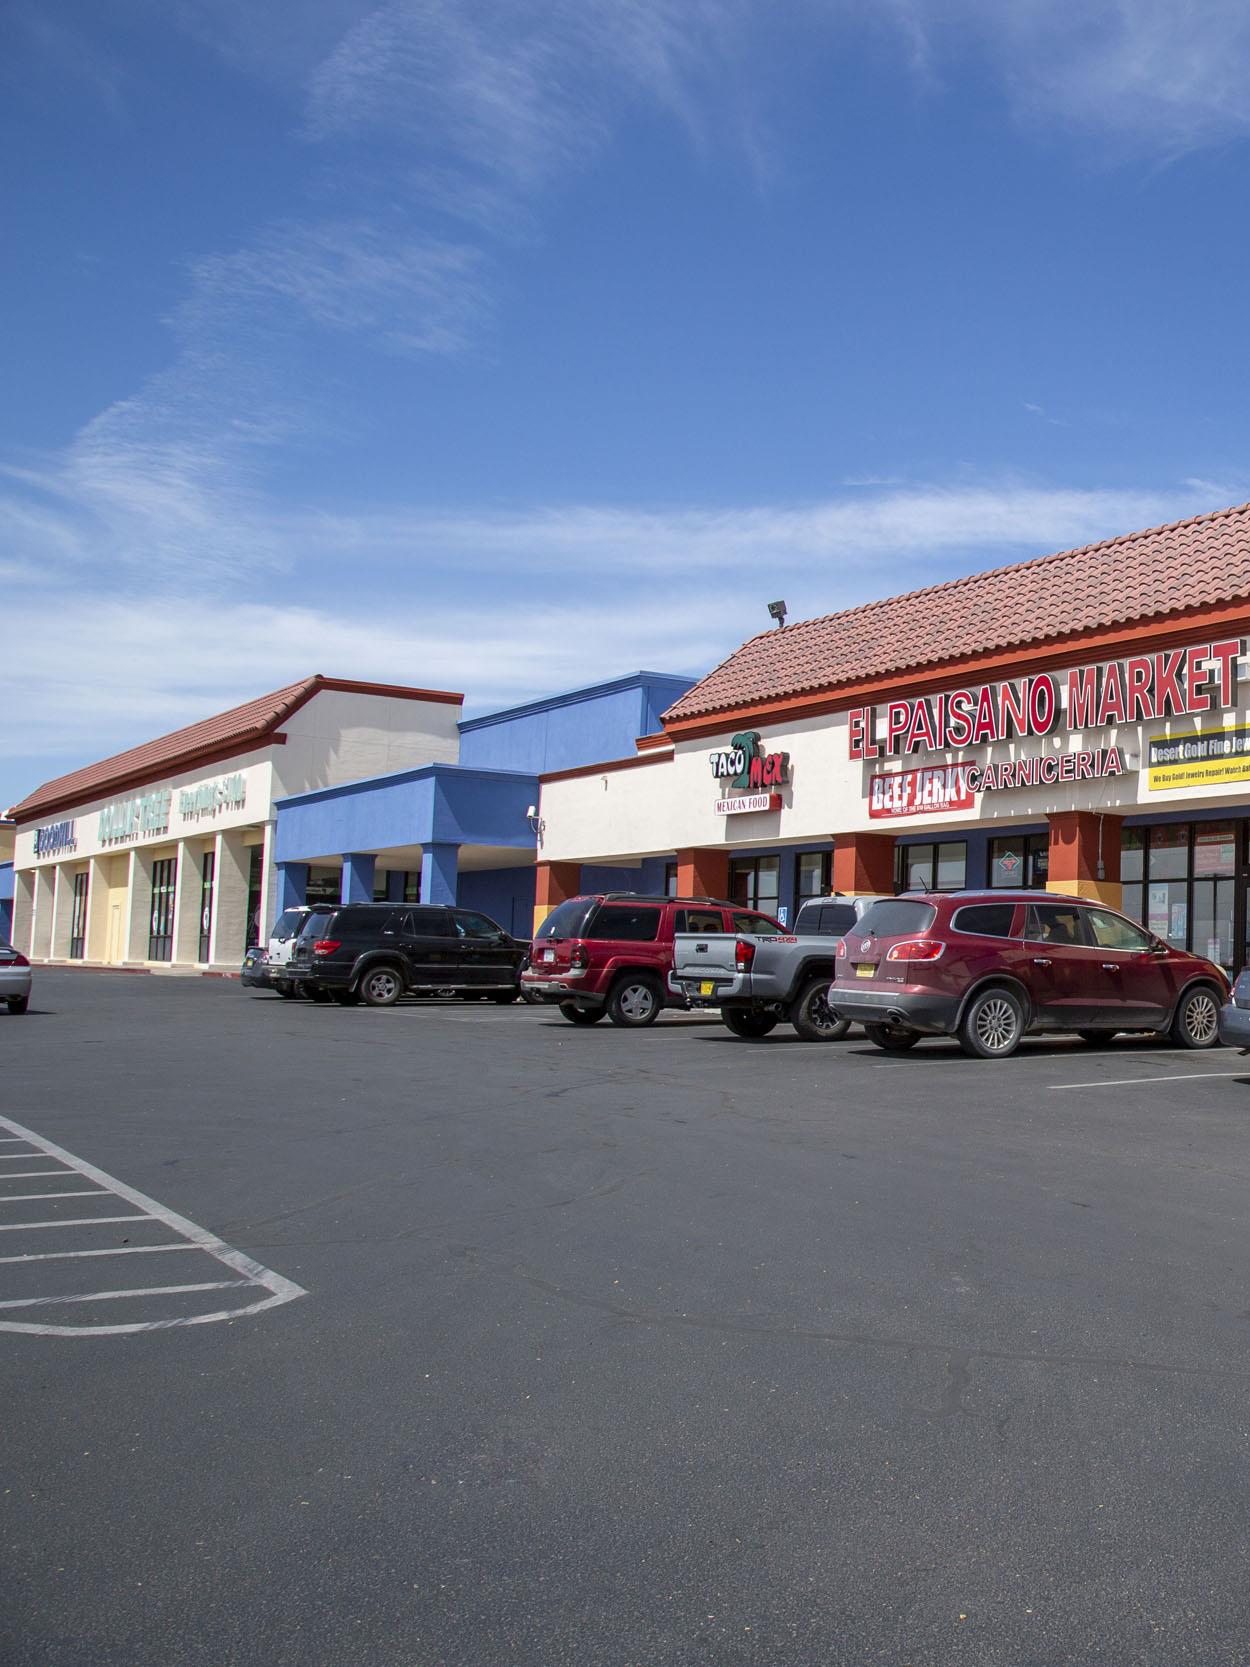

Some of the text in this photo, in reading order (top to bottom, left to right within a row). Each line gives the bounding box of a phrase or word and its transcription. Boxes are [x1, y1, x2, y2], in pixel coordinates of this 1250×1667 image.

[848, 639, 1240, 761] EL PAISANO MARKET
[710, 749, 744, 778] TACO
[965, 746, 1123, 792] CARNICERIA
[1151, 743, 1184, 763] Desert
[1185, 740, 1207, 758] Gold
[1209, 739, 1231, 755] Fine
[717, 796, 767, 813] MEXICAN FOOD
[872, 765, 971, 810] BEEF JERKY
